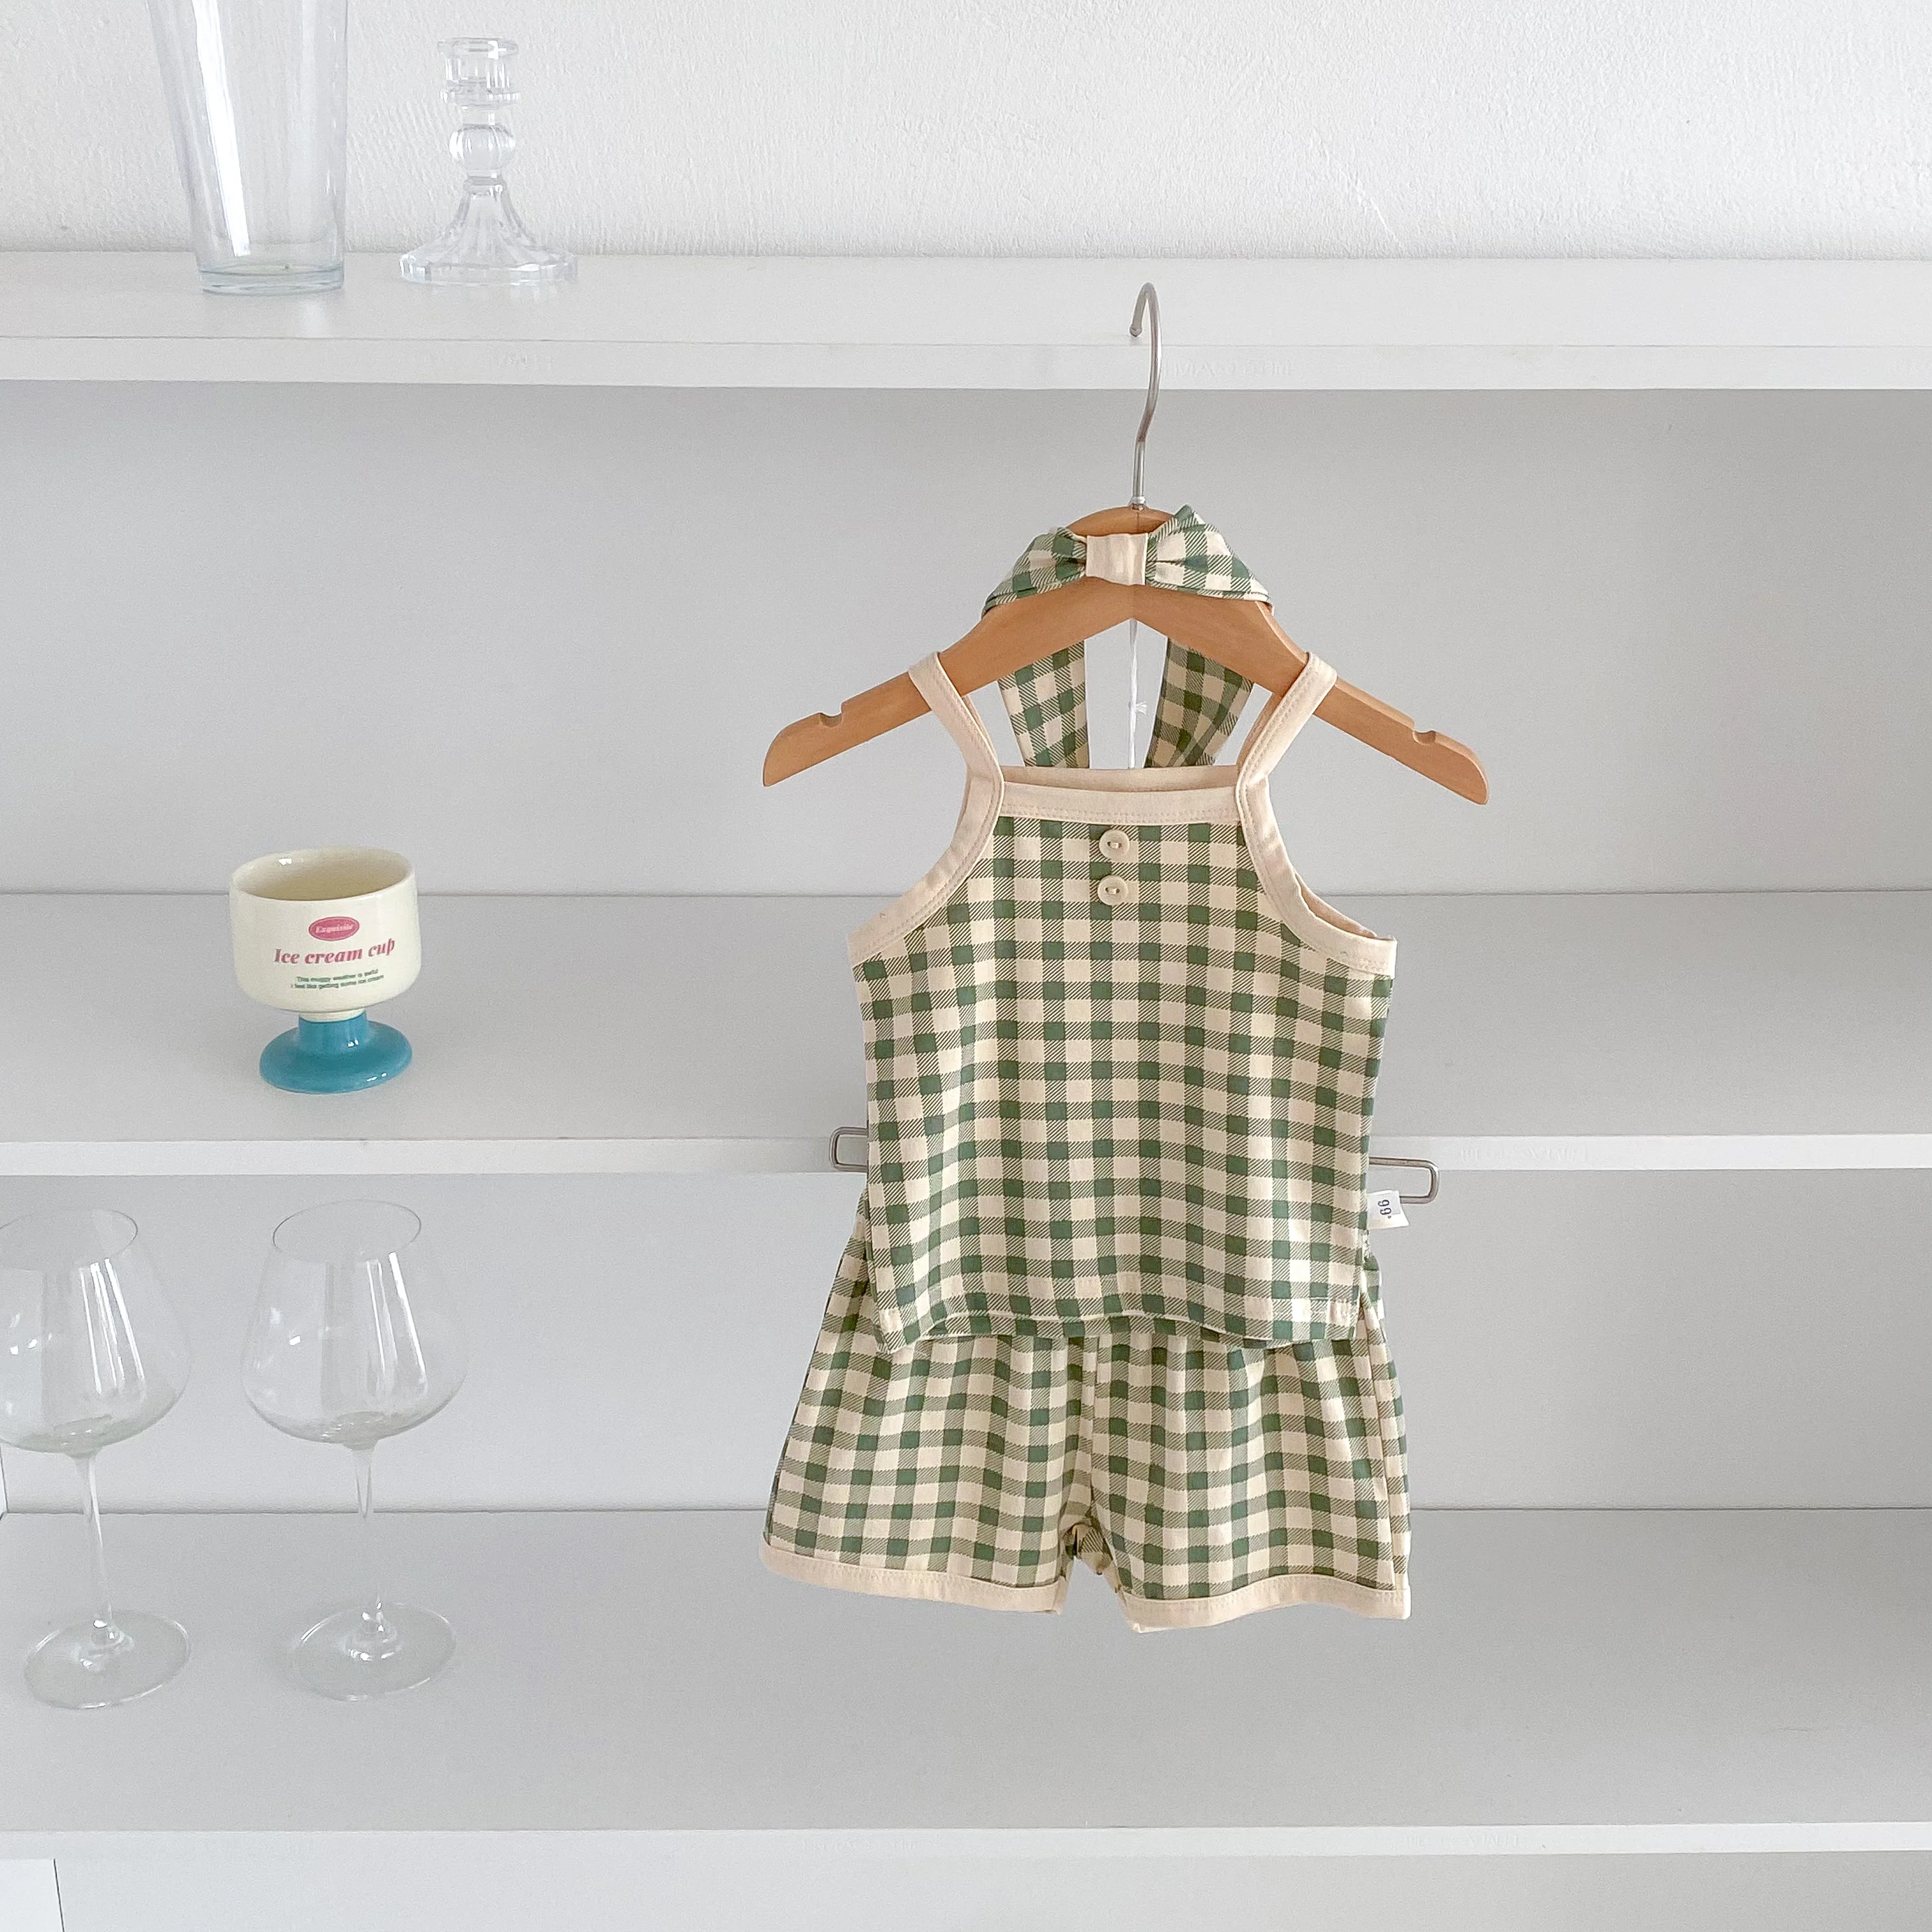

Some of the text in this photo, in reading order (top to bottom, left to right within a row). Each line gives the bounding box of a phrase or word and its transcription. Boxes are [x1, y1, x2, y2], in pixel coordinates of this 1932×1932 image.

[273, 938, 395, 963] Ice cream cup
